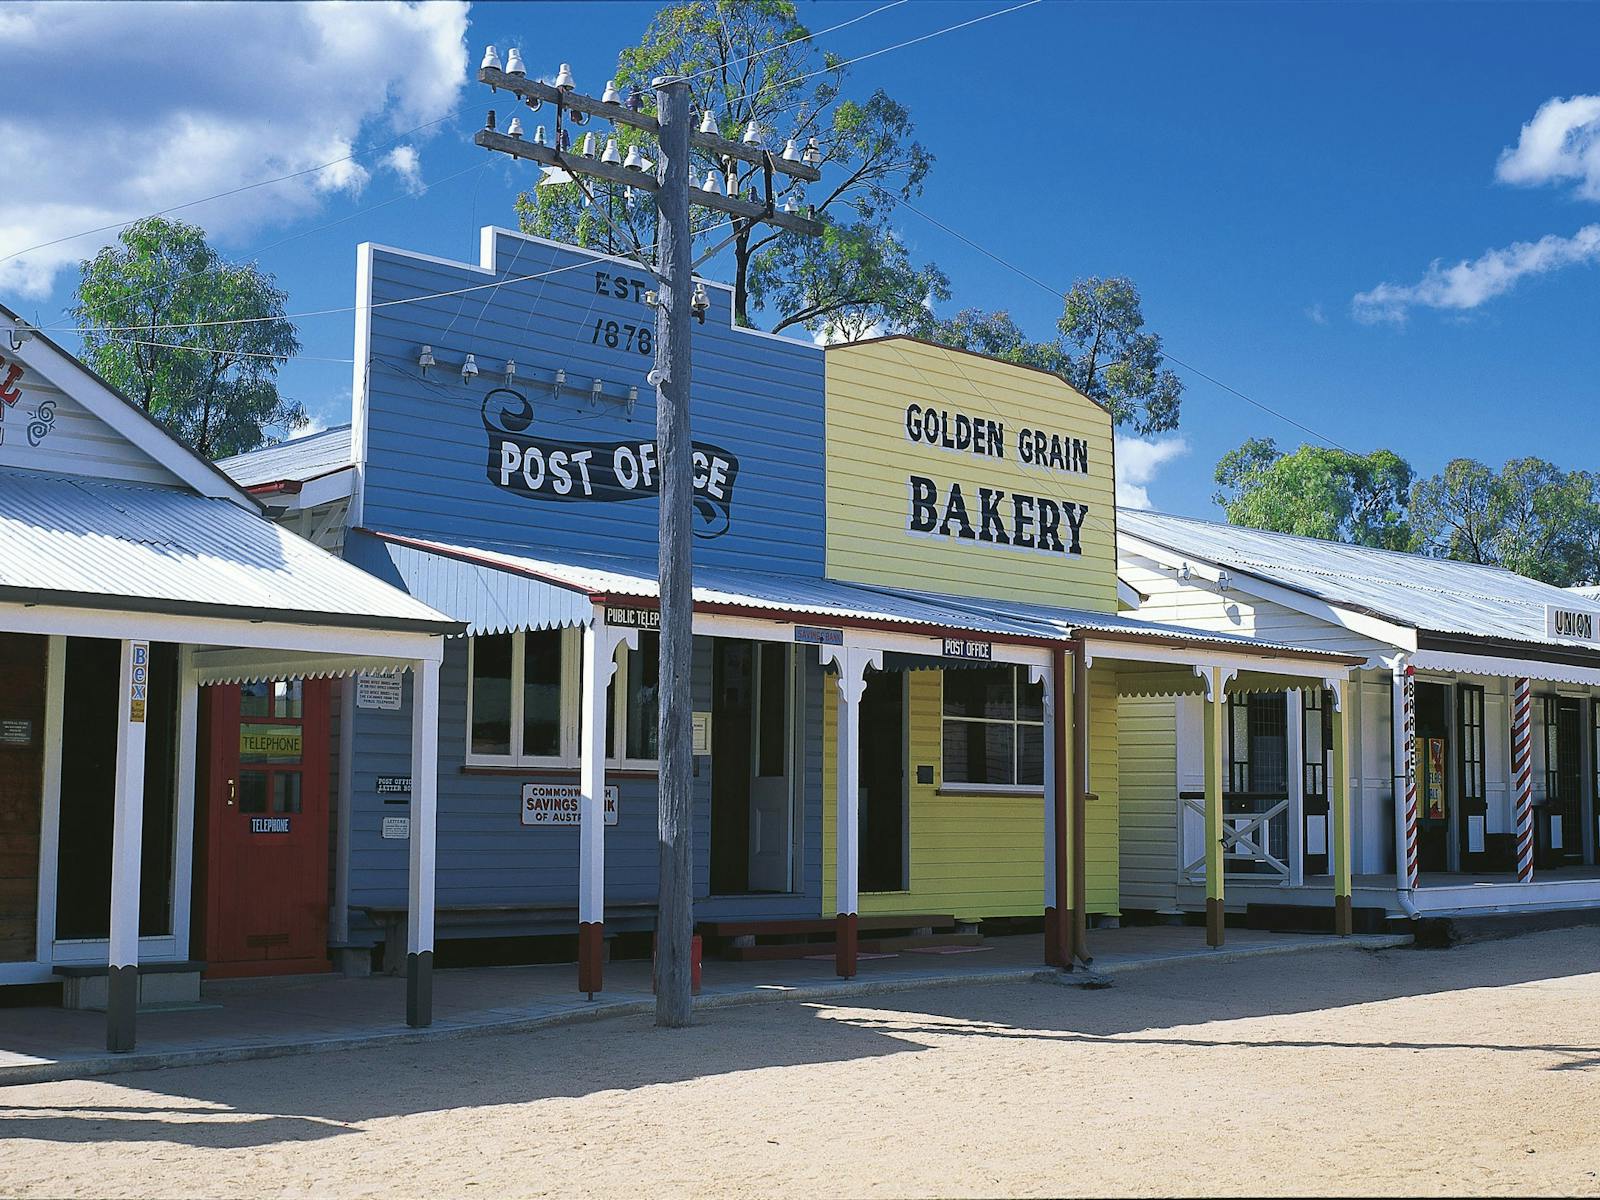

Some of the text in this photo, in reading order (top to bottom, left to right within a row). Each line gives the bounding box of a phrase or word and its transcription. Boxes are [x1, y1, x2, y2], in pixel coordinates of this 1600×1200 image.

[592, 319, 652, 355] 1878
[906, 403, 1088, 474] GOLDEN GRAIN
[500, 441, 729, 500] POST OFCE
[908, 475, 1089, 556] BAKERY
[607, 608, 660, 626] PUBLIC TELEP
[1555, 610, 1592, 639] UNION
[945, 639, 989, 658] POST OFFICE
[132, 646, 147, 700] Bex
[243, 736, 300, 751] TELEPHONE
[532, 787, 611, 798] COMMONWH
[527, 797, 578, 812] SAVINGS
[251, 817, 289, 833] TELEPHONE
[536, 812, 549, 821] OF
